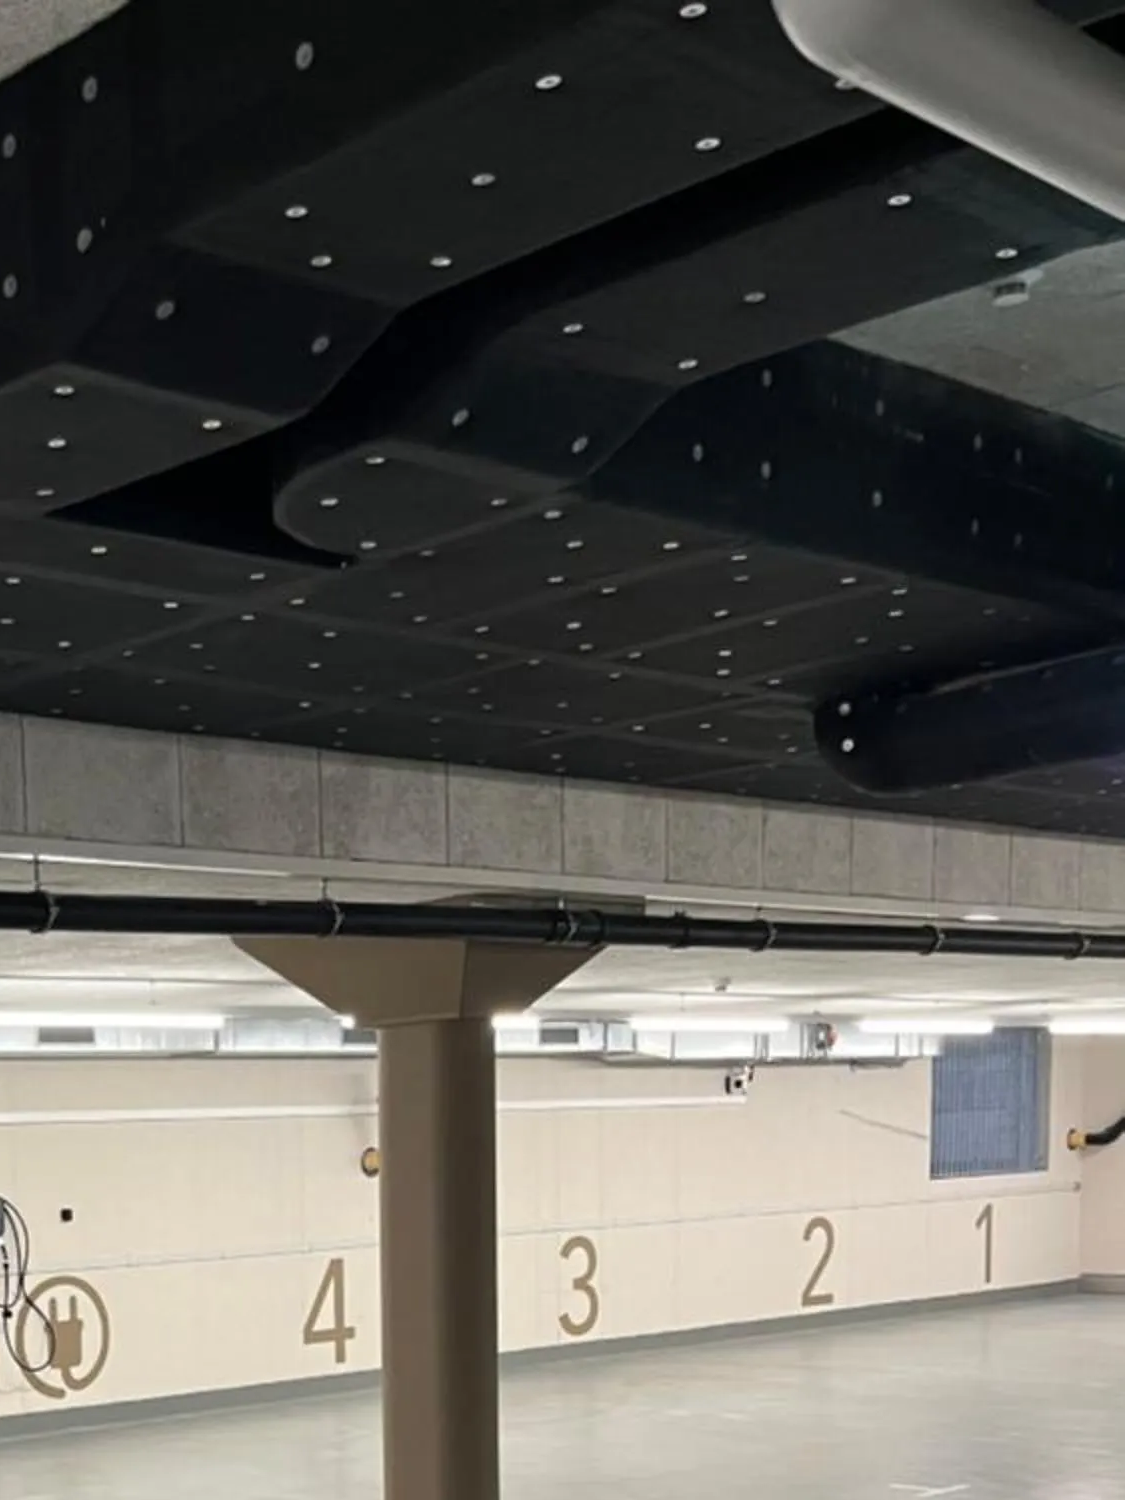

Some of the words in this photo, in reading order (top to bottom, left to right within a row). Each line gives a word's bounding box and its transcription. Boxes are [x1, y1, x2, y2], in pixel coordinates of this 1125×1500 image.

[558, 1236, 599, 1336] 3
[801, 1217, 836, 1306] 2
[975, 1203, 992, 1284] 1
[304, 1258, 355, 1363] 4
